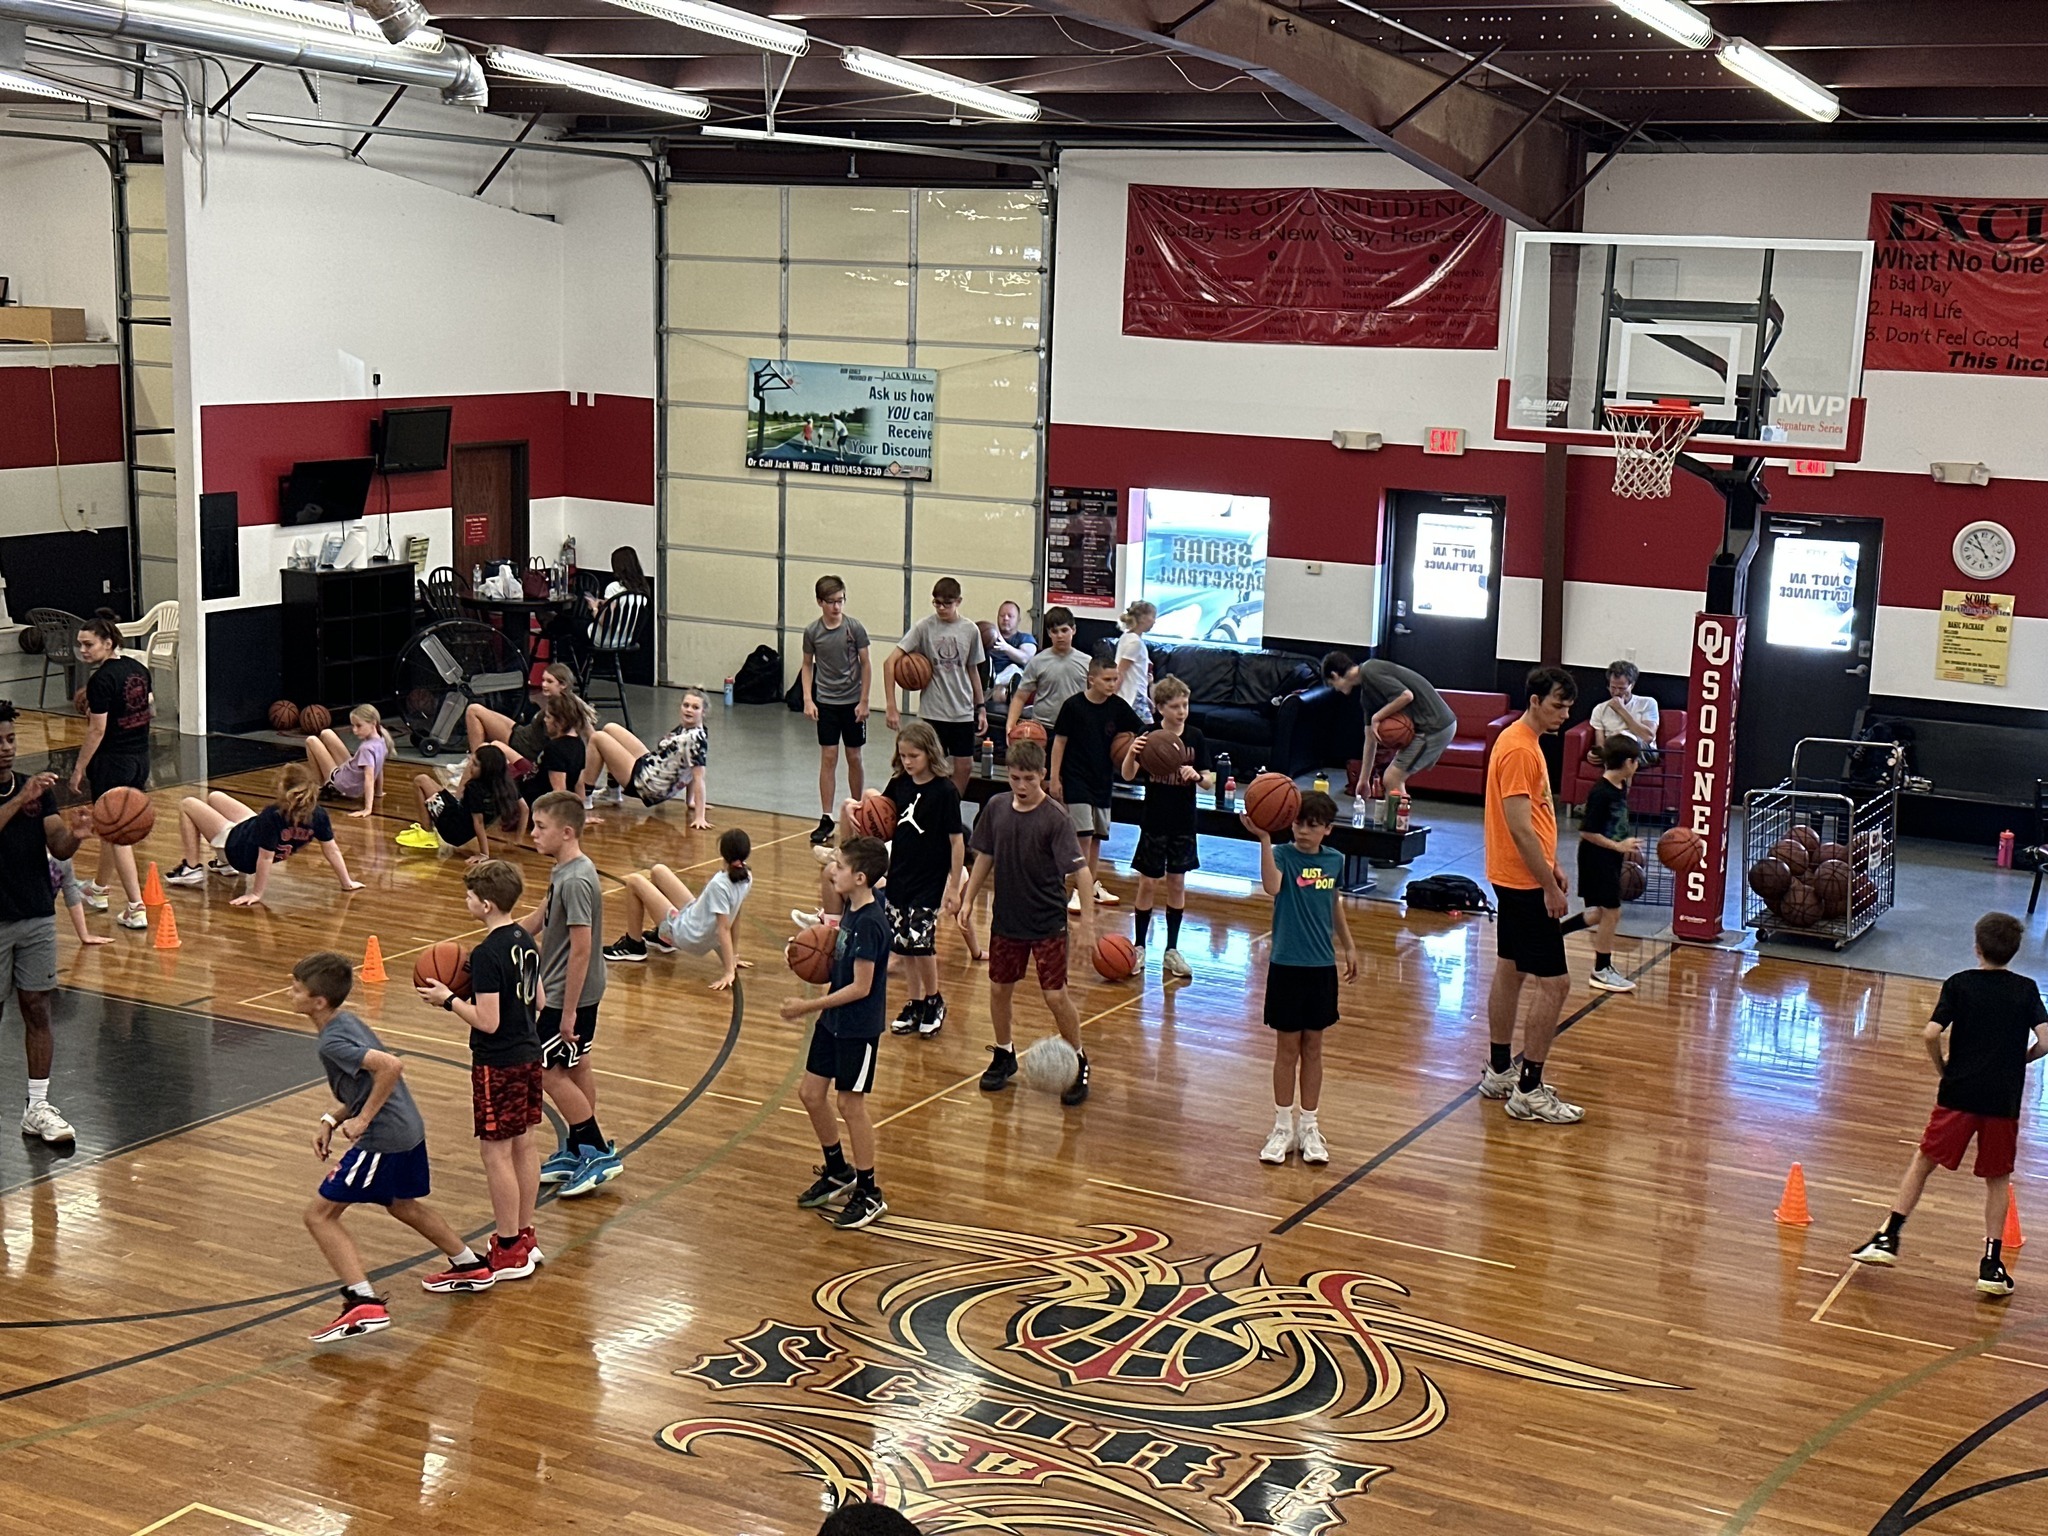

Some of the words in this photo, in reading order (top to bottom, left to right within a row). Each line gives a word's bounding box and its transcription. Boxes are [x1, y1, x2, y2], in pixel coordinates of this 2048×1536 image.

[1298, 195, 1493, 219] CONFIDENC
[1155, 219, 1217, 243] Today
[1224, 224, 1242, 240] is
[1248, 227, 1262, 241] a
[1269, 224, 1319, 242] New
[1873, 246, 1939, 272] What
[1946, 249, 1983, 273] No
[1991, 250, 2046, 274] One
[1889, 274, 1916, 293] Bad
[1921, 276, 1952, 298] Day
[1870, 300, 1884, 317] 2.
[1889, 300, 1928, 319] Hard
[1933, 300, 1963, 319] Life
[1885, 326, 1932, 345] Don't
[1936, 326, 1968, 346] Feel
[1972, 329, 2019, 350] Good
[1947, 351, 1998, 370] This
[2006, 353, 2048, 372] Inc
[881, 371, 901, 382] JACK
[902, 372, 927, 380] WILLS
[869, 385, 890, 401] Ask
[894, 391, 907, 401] us
[910, 388, 935, 403] how
[887, 405, 911, 421] YOU
[913, 410, 934, 422] can
[1777, 392, 1846, 417] MVP
[888, 424, 933, 440] Receive
[1775, 418, 1816, 433] Signature
[1818, 420, 1844, 435] Series
[852, 440, 879, 455] Your
[882, 442, 932, 459] Discount
[1429, 429, 1459, 453] EXIT
[747, 457, 757, 467] Or
[759, 458, 773, 468] Call
[775, 459, 791, 469] Jack
[792, 460, 809, 471] Wills
[811, 462, 821, 472] III
[823, 464, 830, 473] at
[1965, 593, 1991, 606] SCORE
[1301, 867, 1322, 879] JUST
[1315, 878, 1327, 889] DO
[1328, 878, 1335, 889] IT
